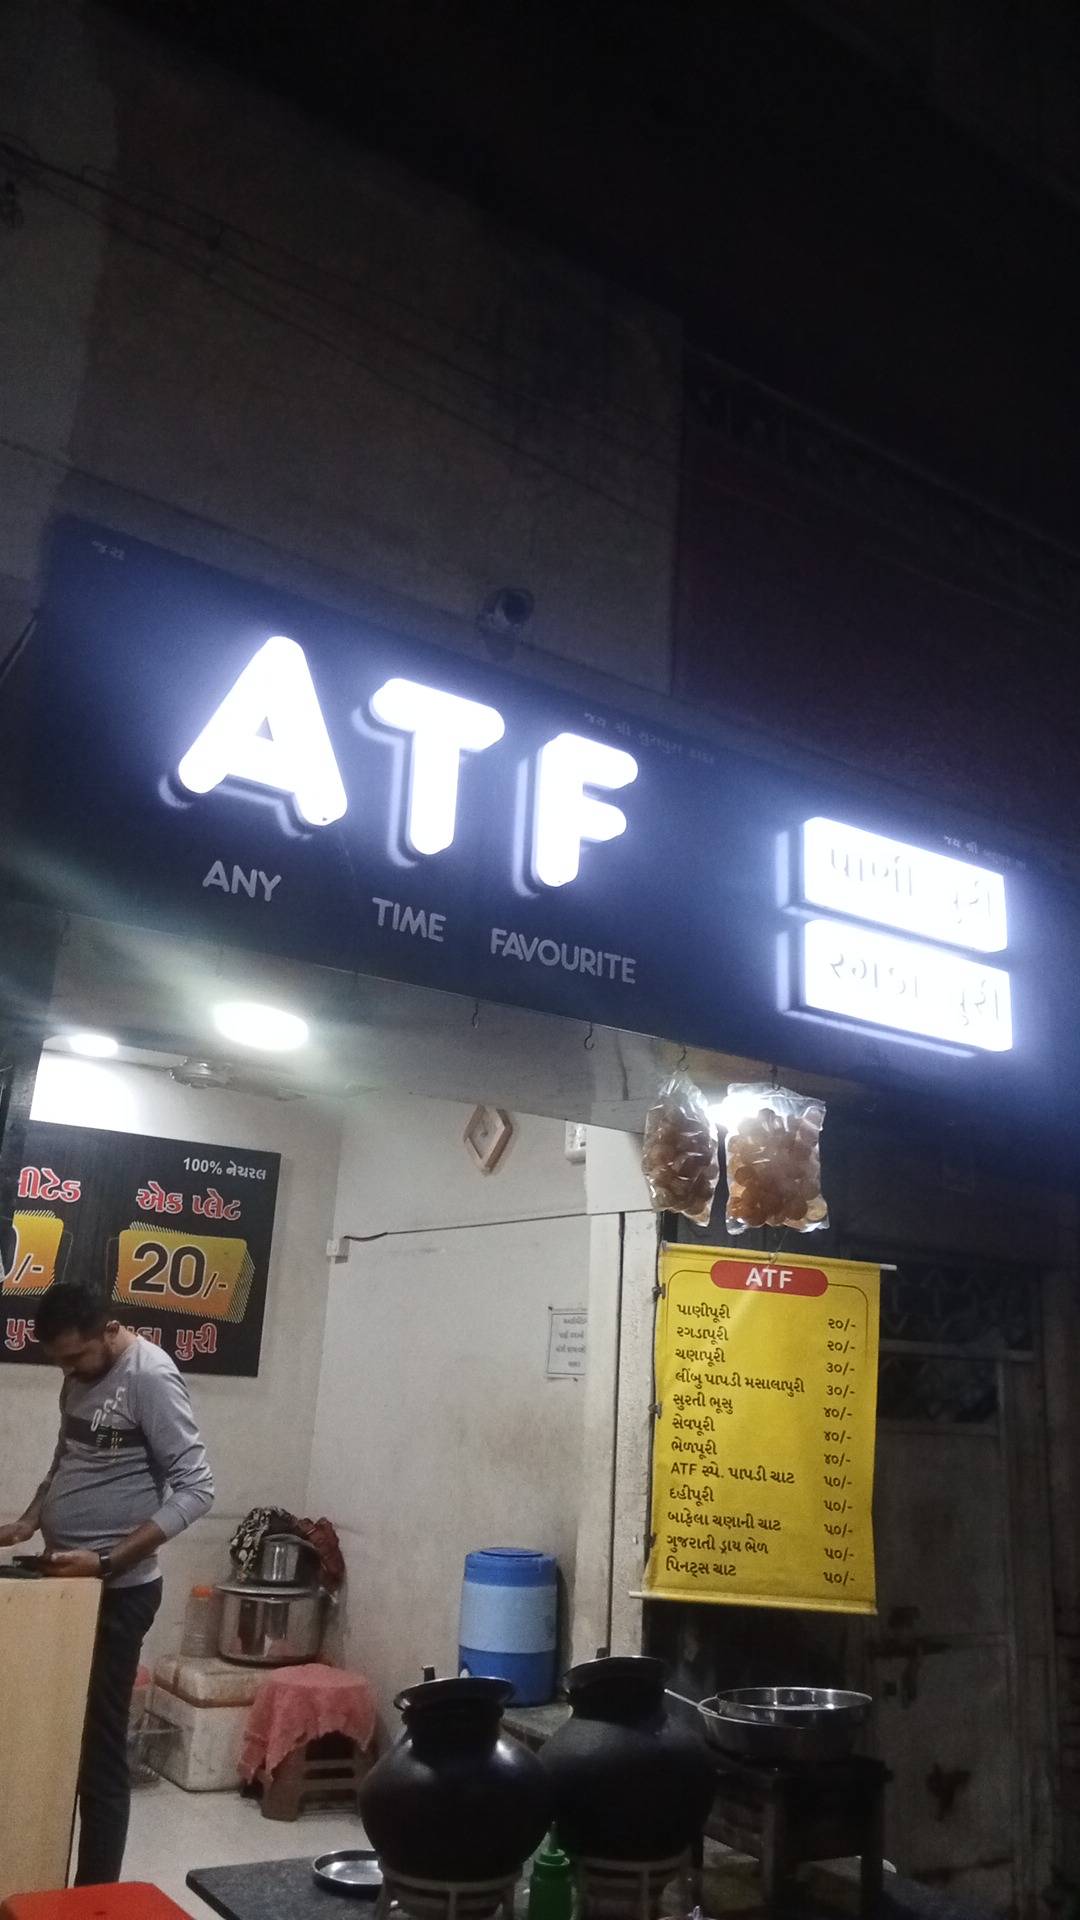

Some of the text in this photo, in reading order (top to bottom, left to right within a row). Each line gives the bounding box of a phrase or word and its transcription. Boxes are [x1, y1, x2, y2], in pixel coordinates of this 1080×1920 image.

[178, 635, 638, 888] ATF
[202, 860, 637, 985] ANY TIME FAVOURITE
[183, 1156, 267, 1180] 100% નેચરલ
[135, 1181, 242, 1221] એક પ્લેટ
[129, 1241, 228, 1299] 20/-
[746, 1267, 793, 1289] ATF
[677, 1303, 730, 1323] પાણીપૂરી
[175, 1322, 218, 1362] પુરી
[677, 1326, 729, 1345] રગડાપૂરી
[675, 1348, 725, 1367] ચણાપૂરી
[705, 1372, 742, 1388] પાપડી
[673, 1391, 706, 1411] સુરતી
[670, 1463, 697, 1476] ATF
[728, 1466, 768, 1482] પાપડી
[770, 1470, 795, 1484] ચાટ
[669, 1485, 714, 1506] દહીપૂરી
[712, 1513, 754, 1530] ચણાની
[758, 1517, 781, 1531] ચાટ
[666, 1534, 716, 1554] ગુજરાતી
[744, 1537, 769, 1554] ભેળ
[713, 1562, 736, 1576] ચાટ
